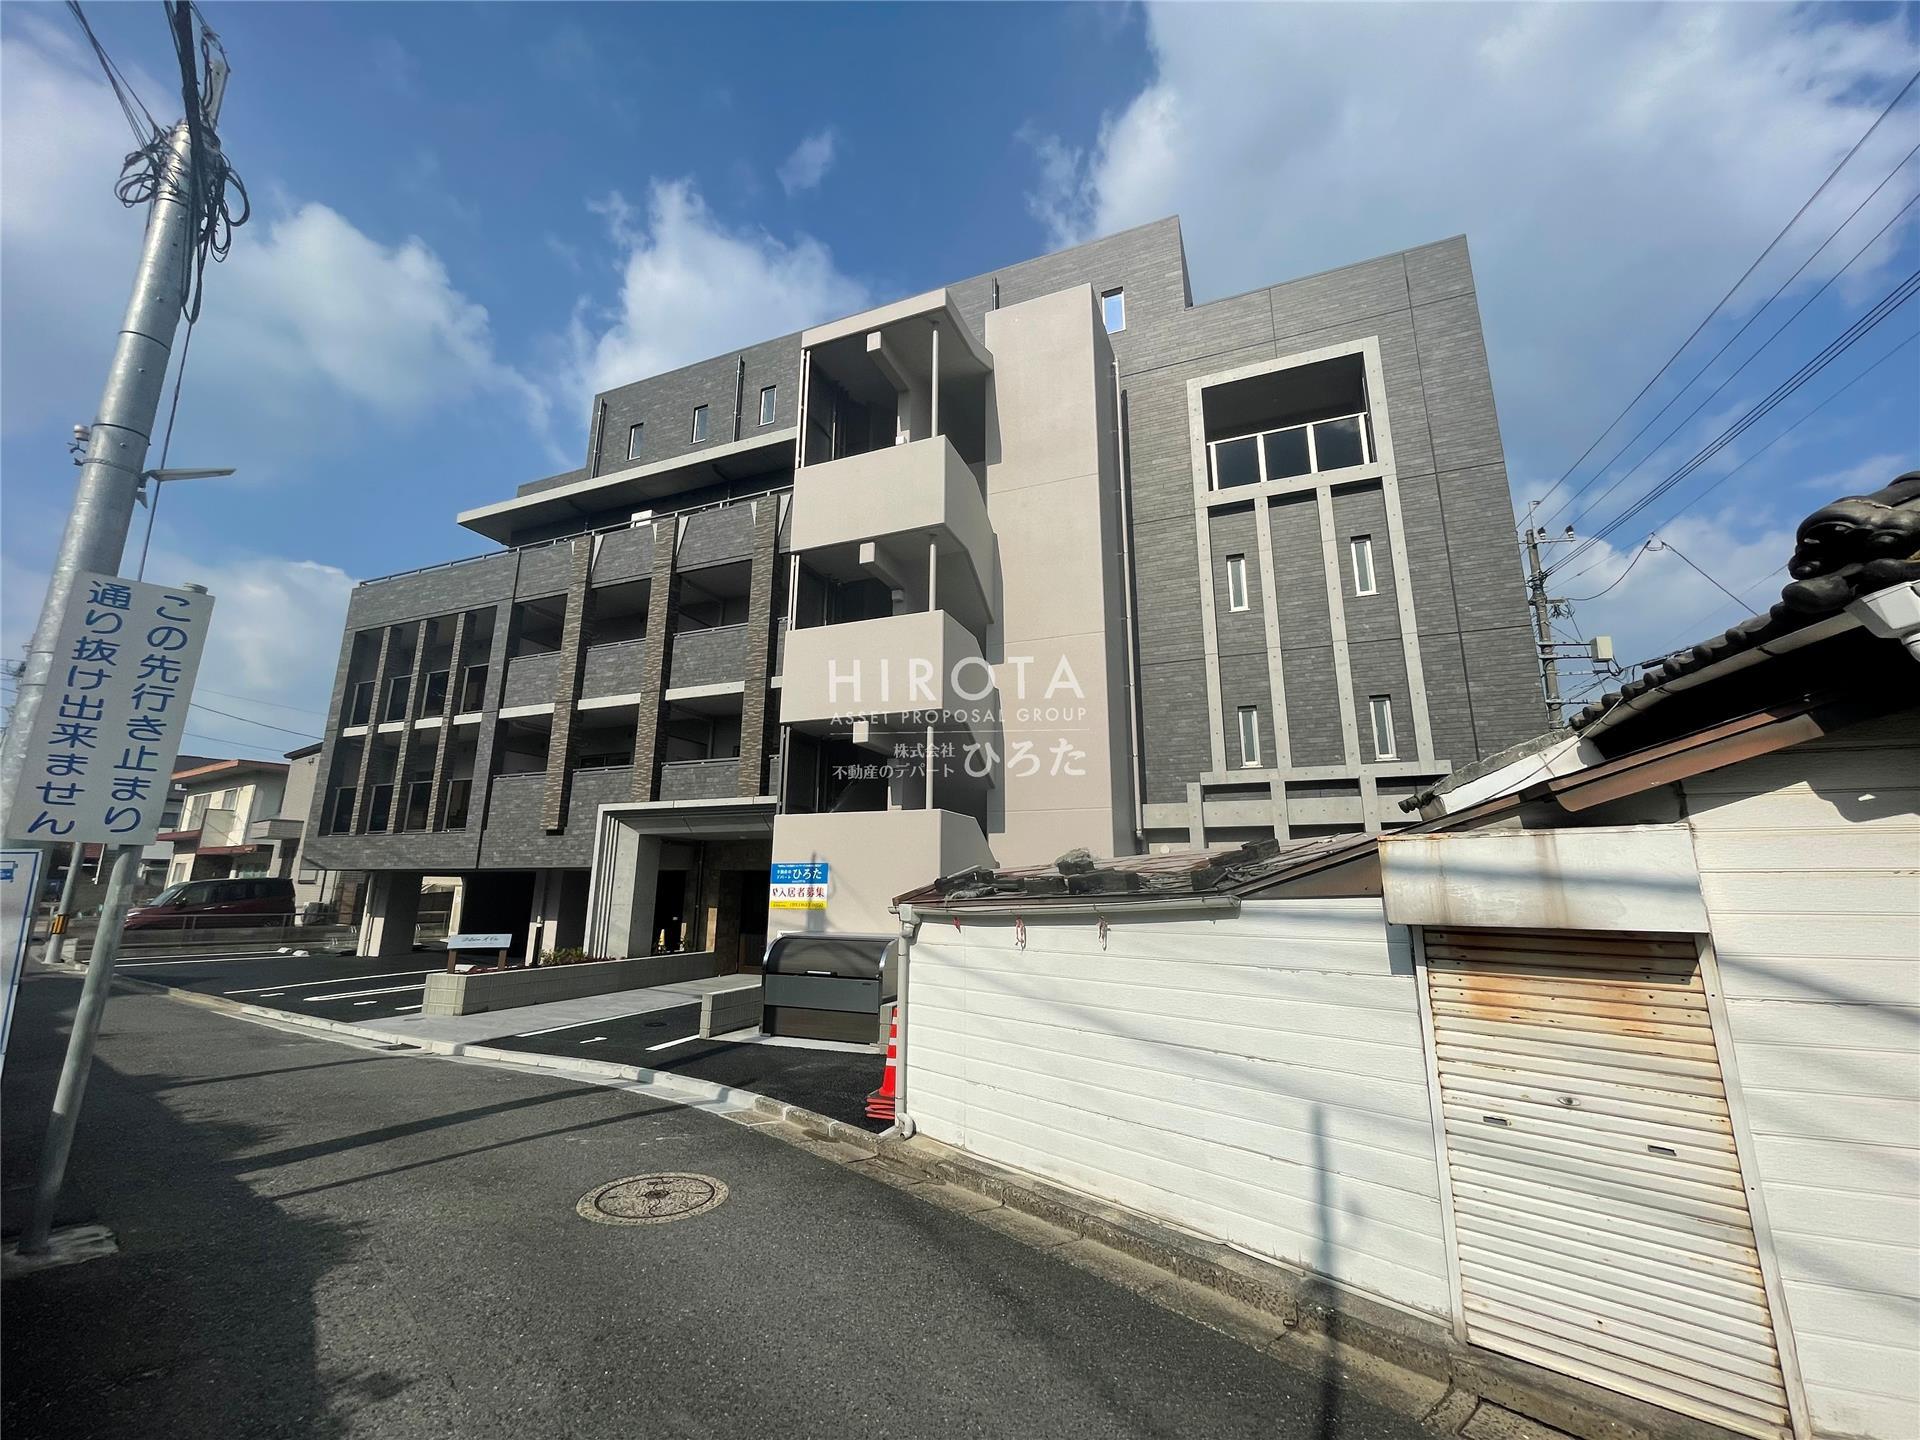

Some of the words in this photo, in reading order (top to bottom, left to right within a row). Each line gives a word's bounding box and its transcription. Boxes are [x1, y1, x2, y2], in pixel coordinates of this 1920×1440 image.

[27, 580, 132, 835] 通り抜け出来ません
[104, 595, 192, 833] この先行き止まり
[792, 868, 822, 880] ひろた
